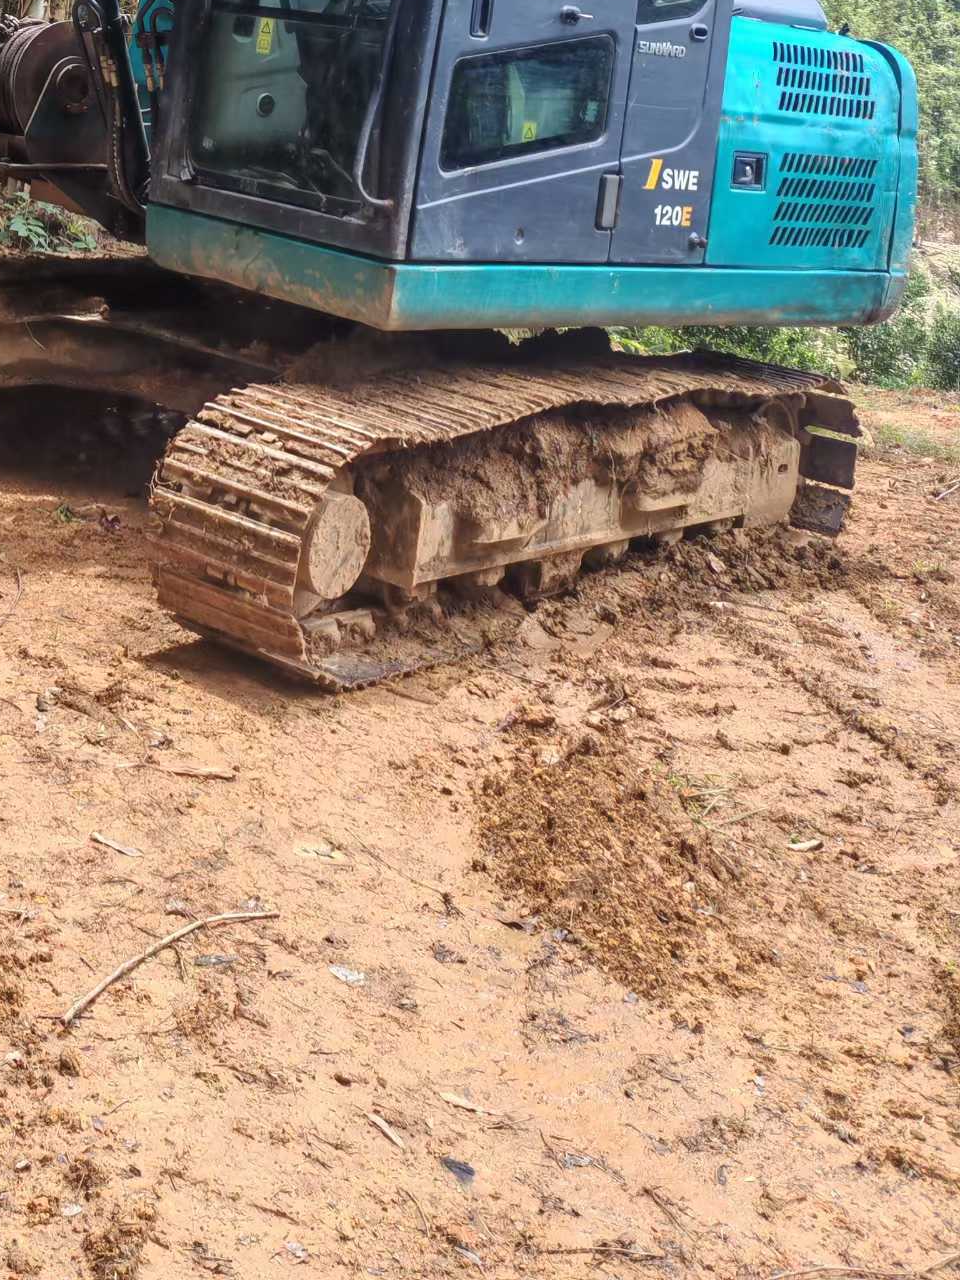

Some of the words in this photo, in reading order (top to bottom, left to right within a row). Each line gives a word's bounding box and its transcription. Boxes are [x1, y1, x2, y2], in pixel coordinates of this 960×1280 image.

[639, 40, 686, 57] SUNWARD
[662, 168, 699, 191] SWE
[654, 205, 693, 227] 120E
